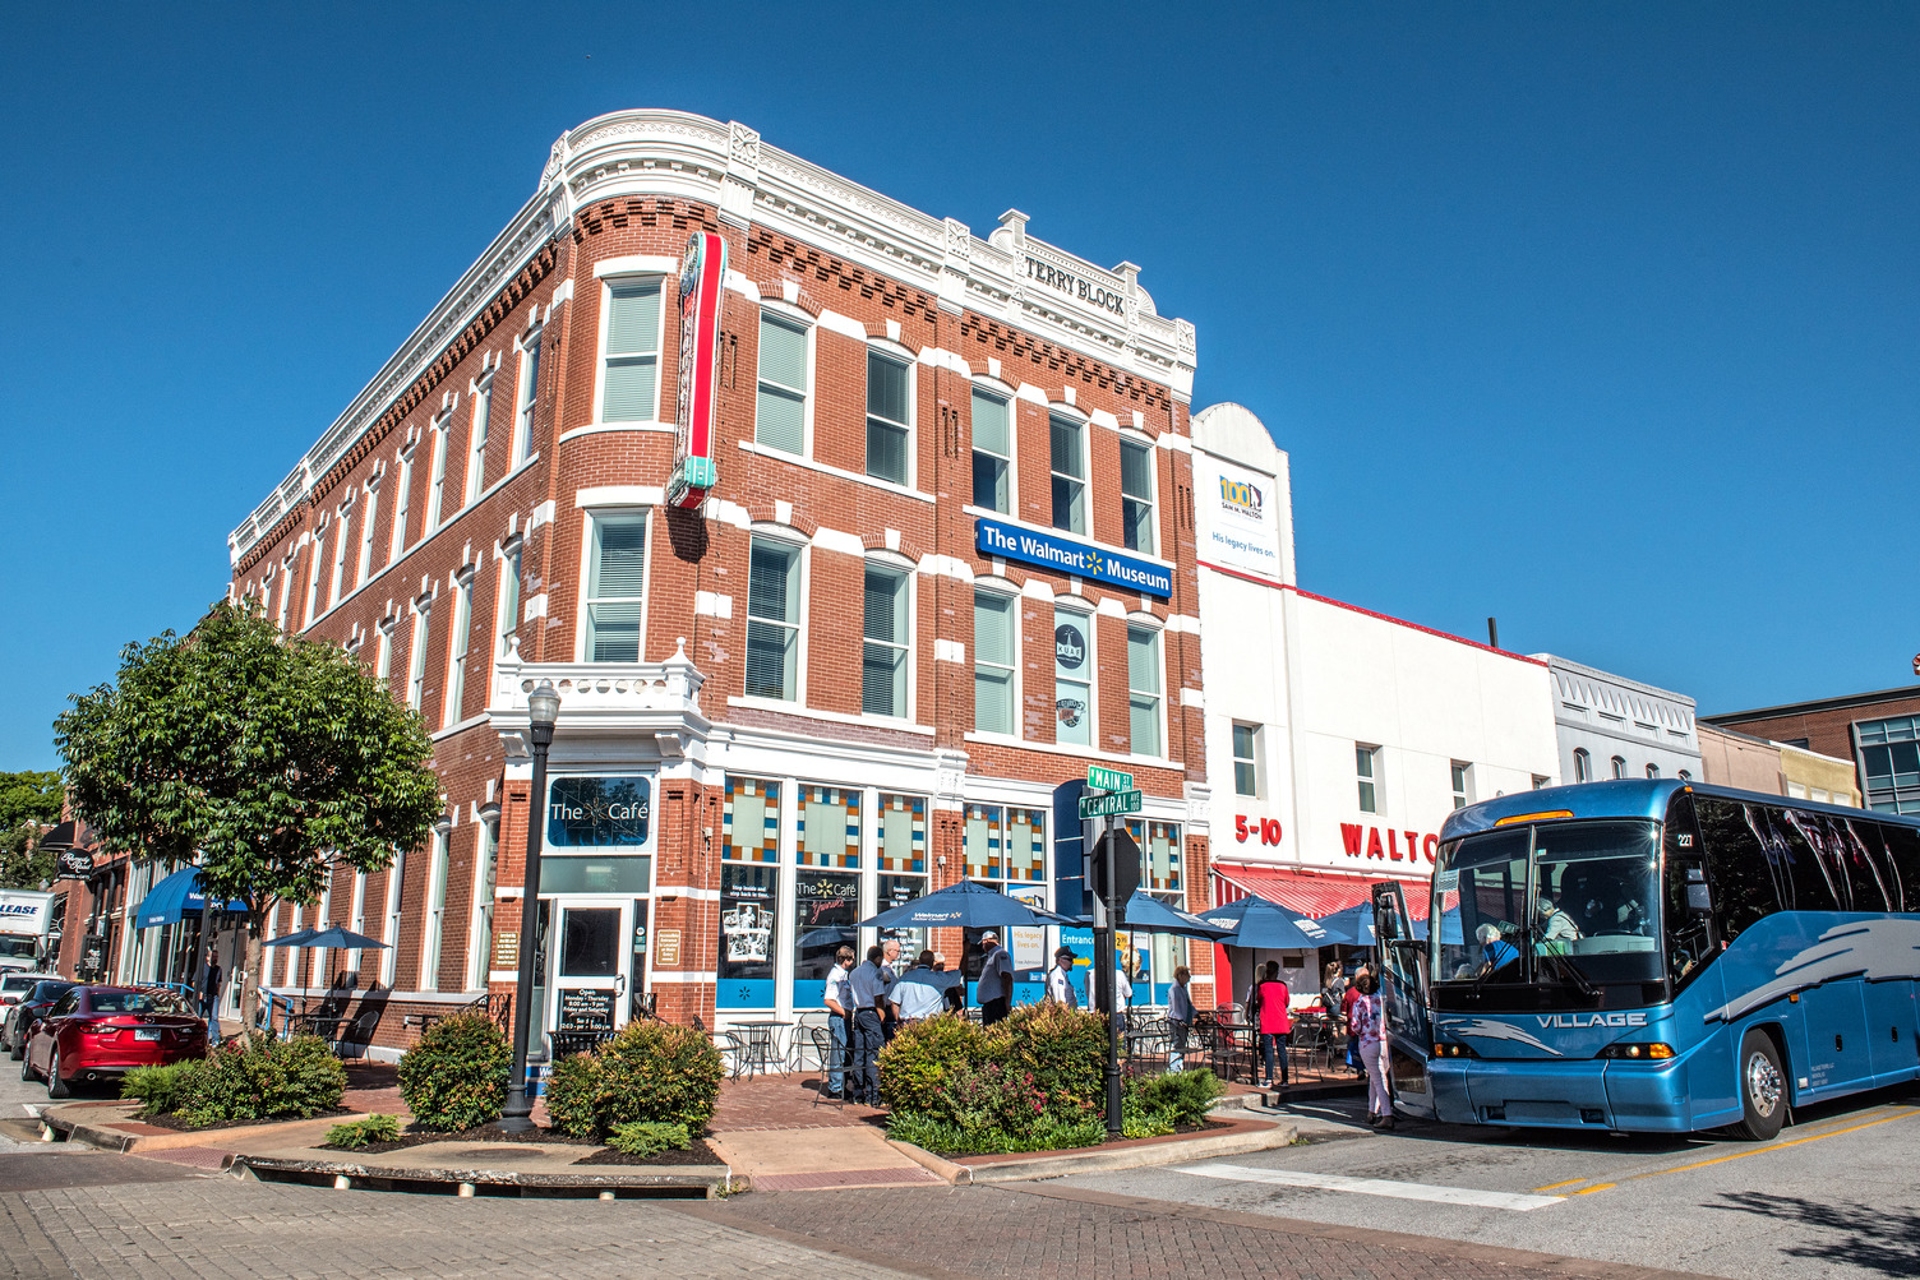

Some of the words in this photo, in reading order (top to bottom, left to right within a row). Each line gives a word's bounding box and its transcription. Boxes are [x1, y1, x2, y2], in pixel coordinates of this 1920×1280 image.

[1025, 256, 1075, 295] TERRY
[1077, 278, 1124, 316] BLOCK
[1220, 478, 1251, 508] 100
[1241, 508, 1262, 520] WALTON
[1212, 531, 1224, 543] His
[1225, 535, 1247, 552] legacy
[1248, 543, 1263, 555] lives
[1264, 549, 1276, 558] on.
[983, 526, 1017, 551] The
[1020, 536, 1085, 569] Walmart
[1107, 558, 1169, 591] Museum
[1095, 769, 1121, 791] MAIN
[551, 802, 583, 820] The
[608, 802, 648, 819] Café
[1087, 794, 1128, 816] CENTRAL
[1235, 814, 1282, 846] 5-10
[1678, 834, 1694, 847] 227
[796, 882, 817, 895] The
[833, 883, 857, 897] Café
[0, 904, 39, 915] LEASE
[1014, 931, 1023, 939] His
[1024, 932, 1043, 941] legacy
[579, 988, 596, 997] Open
[588, 995, 609, 1003] Thursday
[1536, 1012, 1648, 1029] VILLAGE
